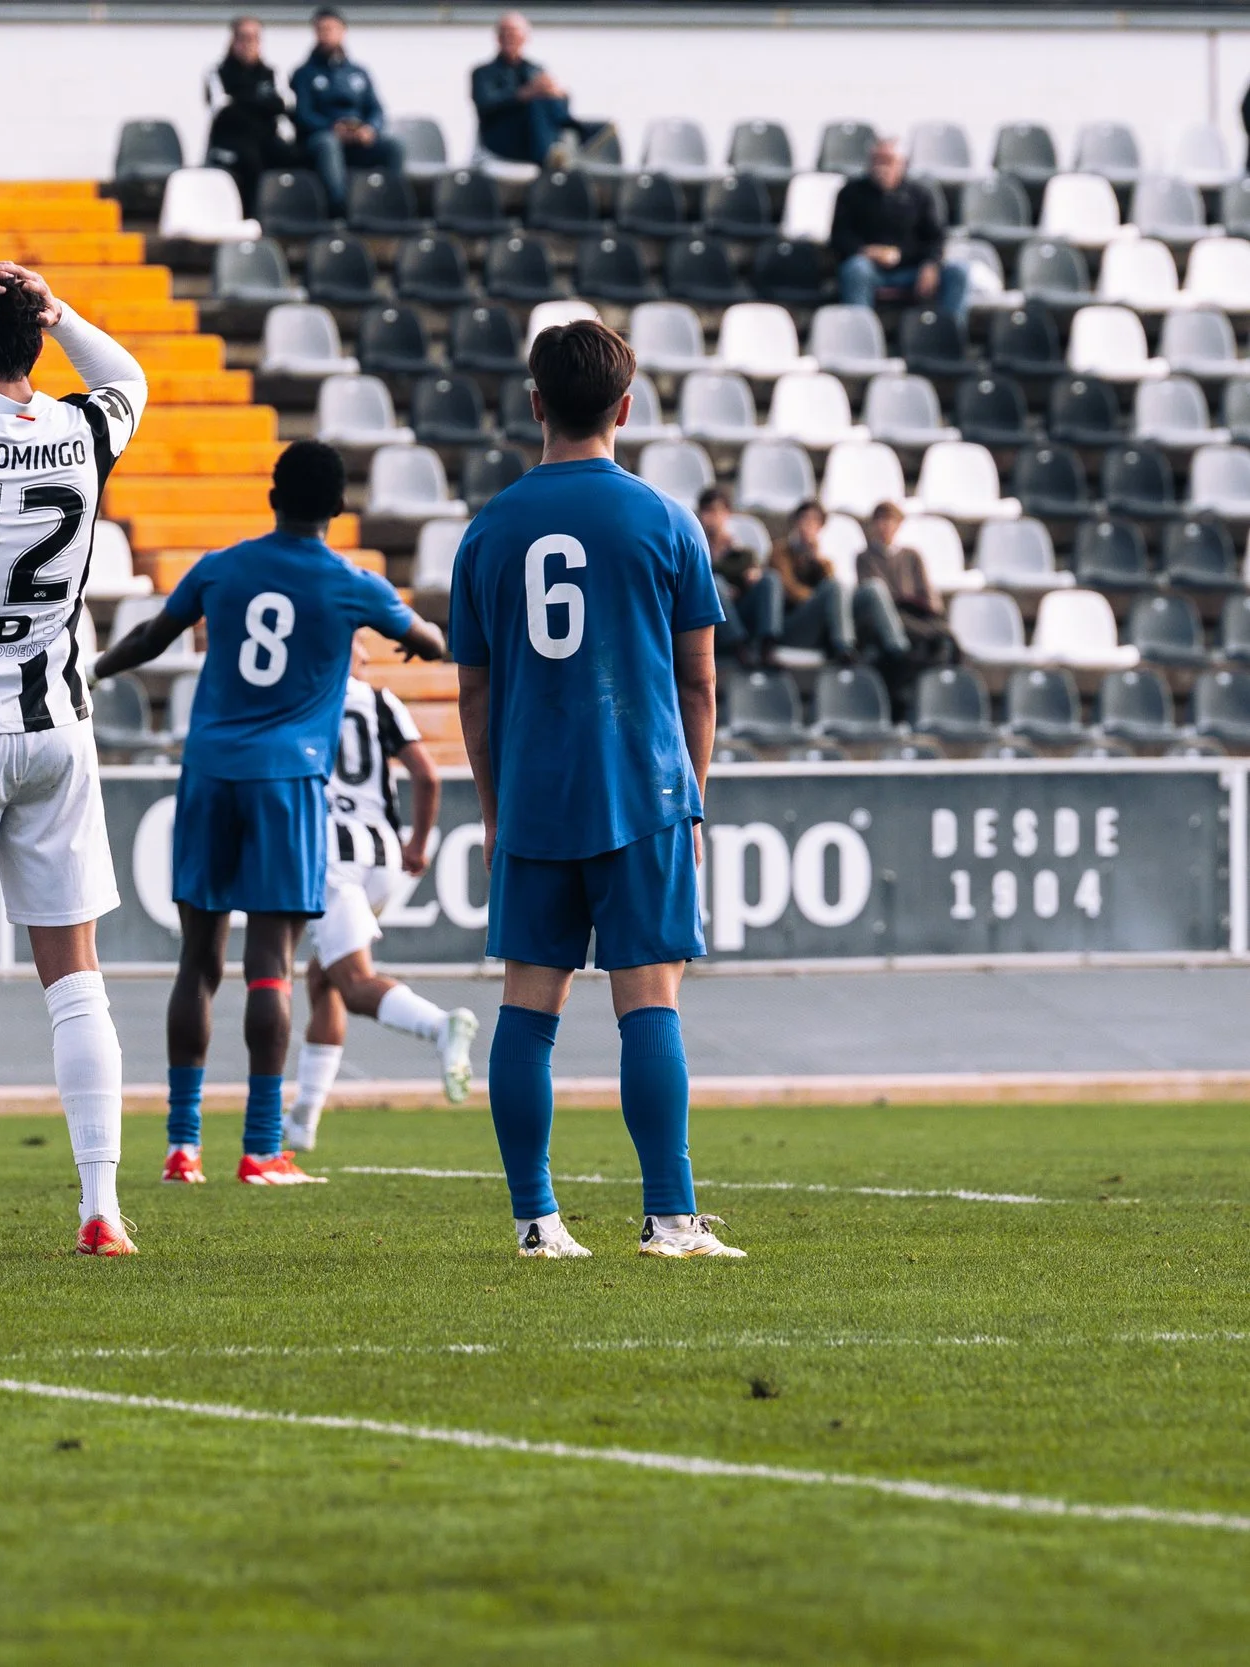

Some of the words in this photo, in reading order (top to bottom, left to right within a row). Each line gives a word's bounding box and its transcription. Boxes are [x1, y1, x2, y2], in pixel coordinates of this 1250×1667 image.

[524, 533, 587, 660] 6
[238, 591, 296, 687] 8
[931, 807, 1120, 859] DESDE
[950, 868, 1103, 920] 1904
